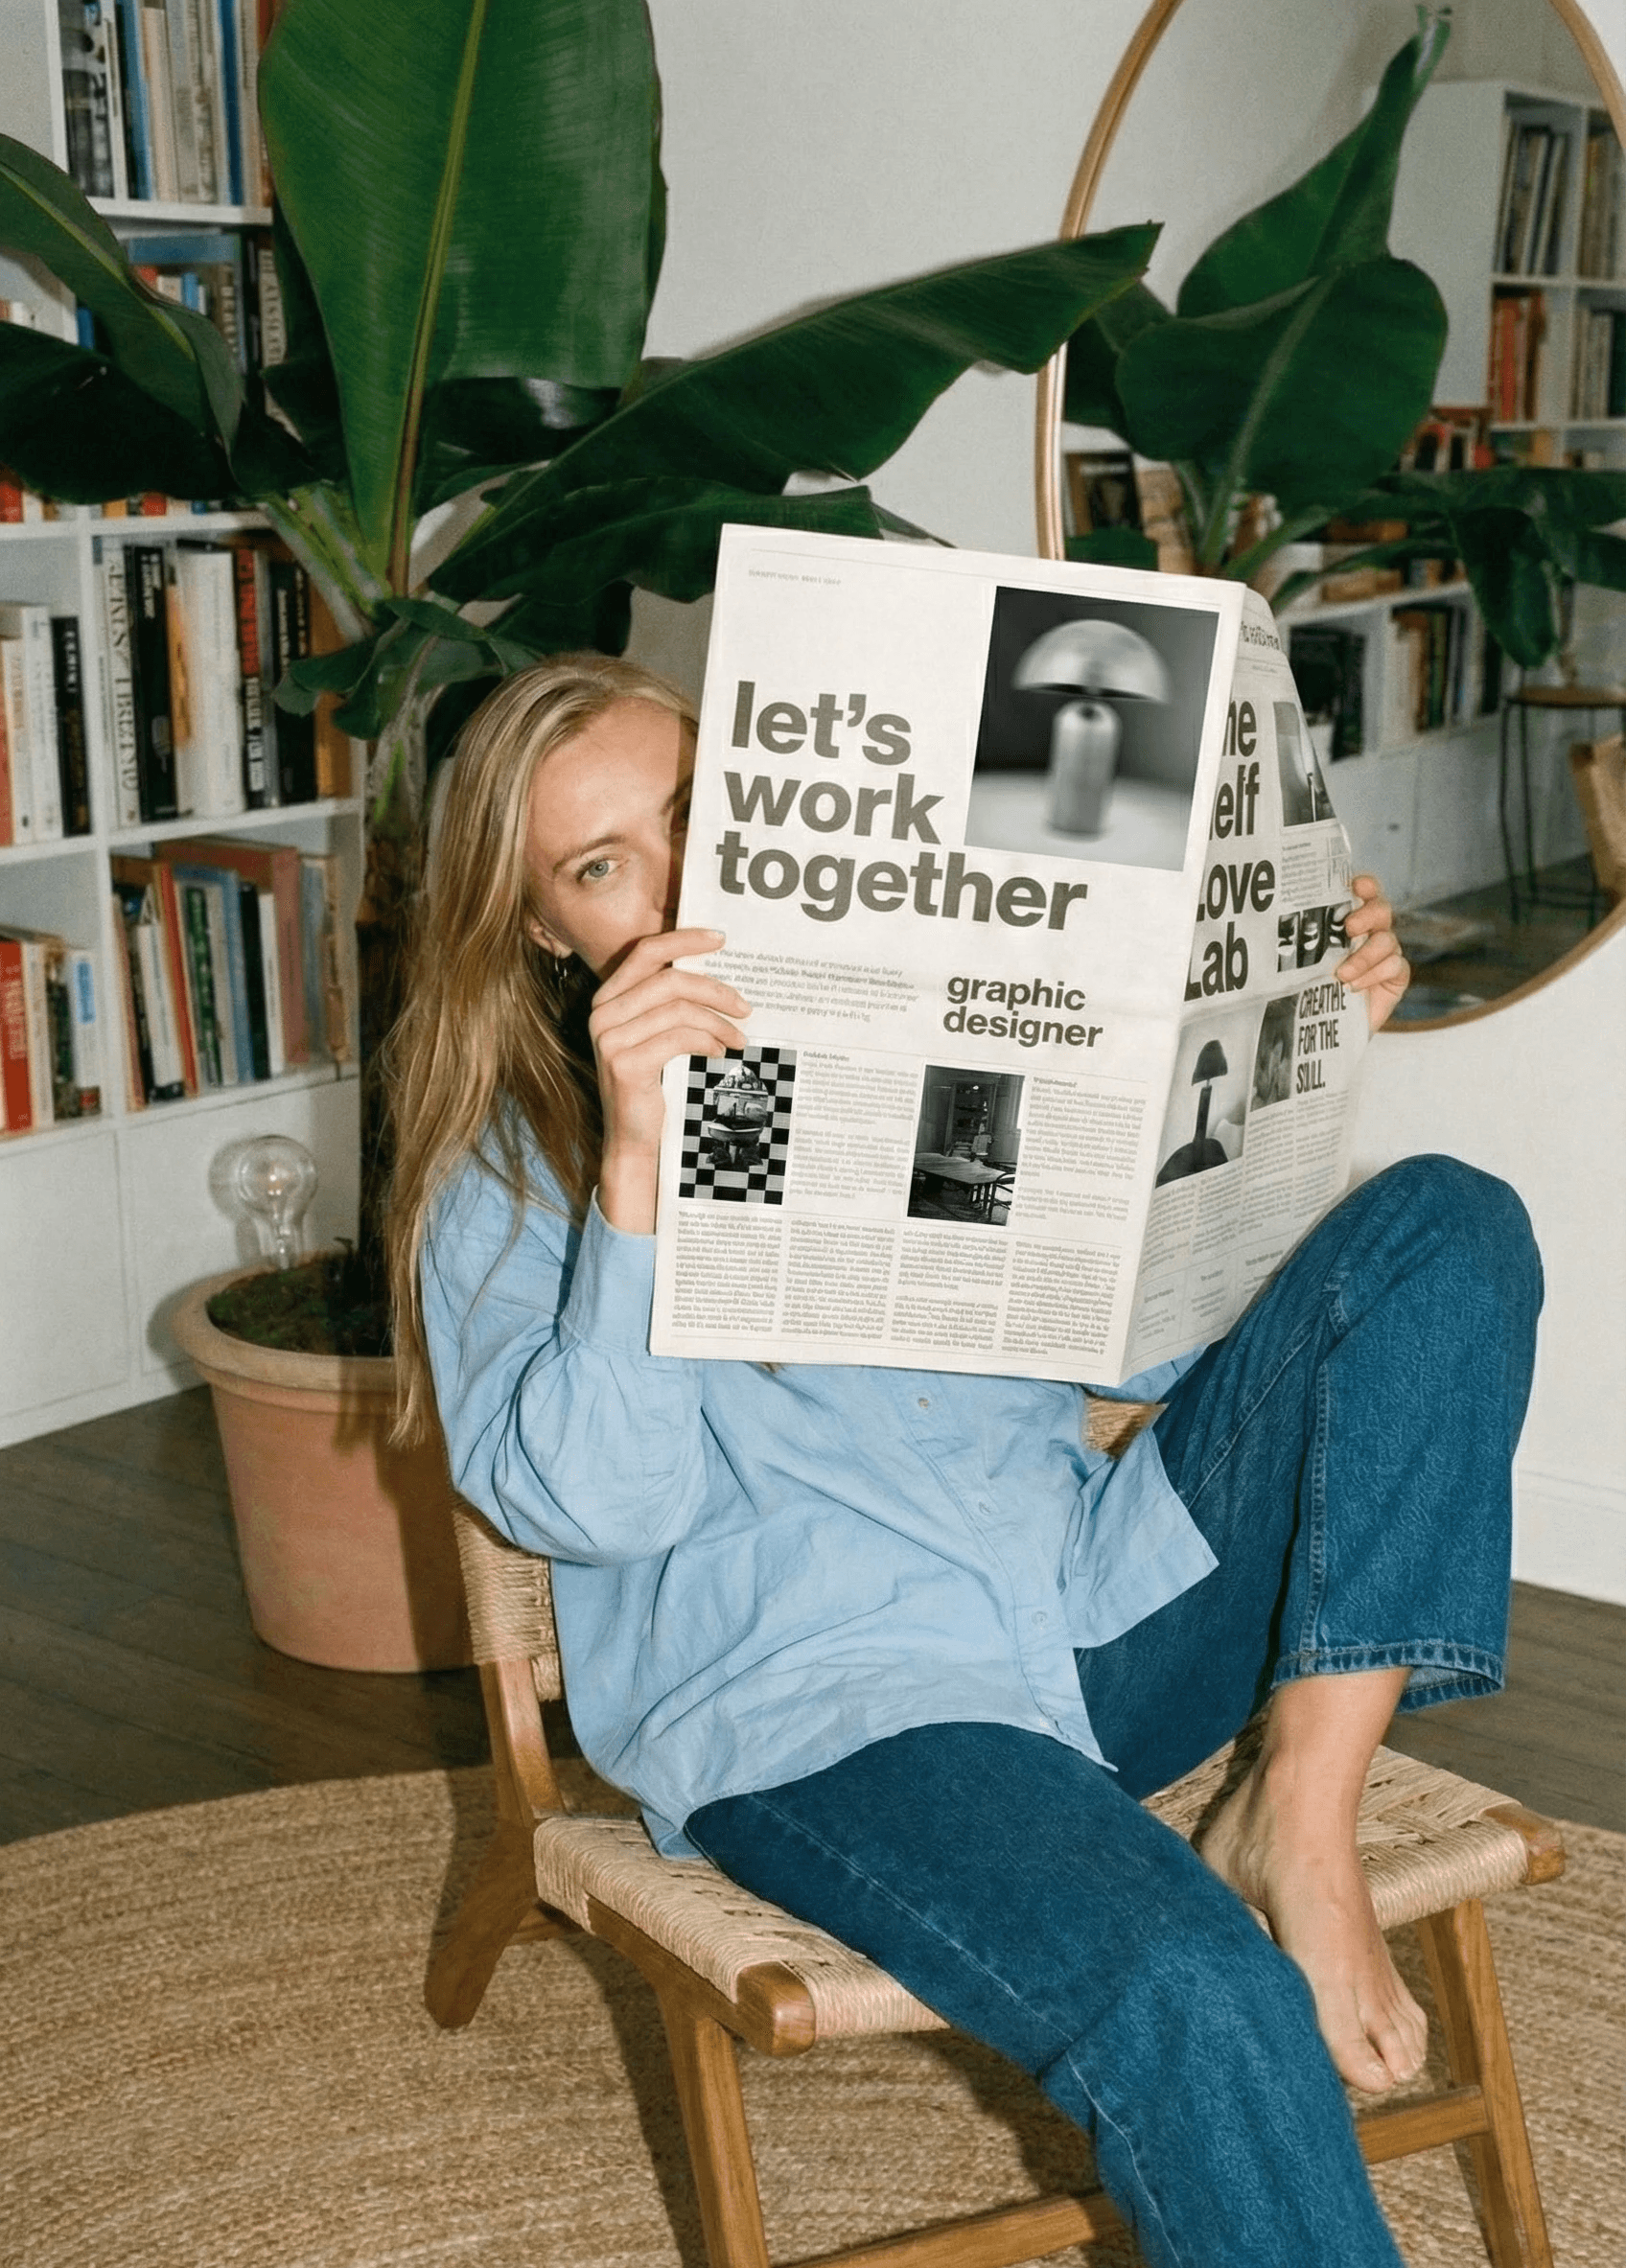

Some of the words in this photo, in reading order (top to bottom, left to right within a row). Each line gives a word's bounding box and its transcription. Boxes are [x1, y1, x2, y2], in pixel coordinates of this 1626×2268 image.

[731, 680, 912, 766] let’s
[724, 771, 944, 845] work
[1209, 761, 1260, 841] elf
[715, 830, 1088, 931] together
[942, 1006, 1103, 1048] designer
[947, 976, 1086, 1011] graphic
[1297, 1024, 1317, 1056] FOR
[1318, 1018, 1339, 1051] THE
